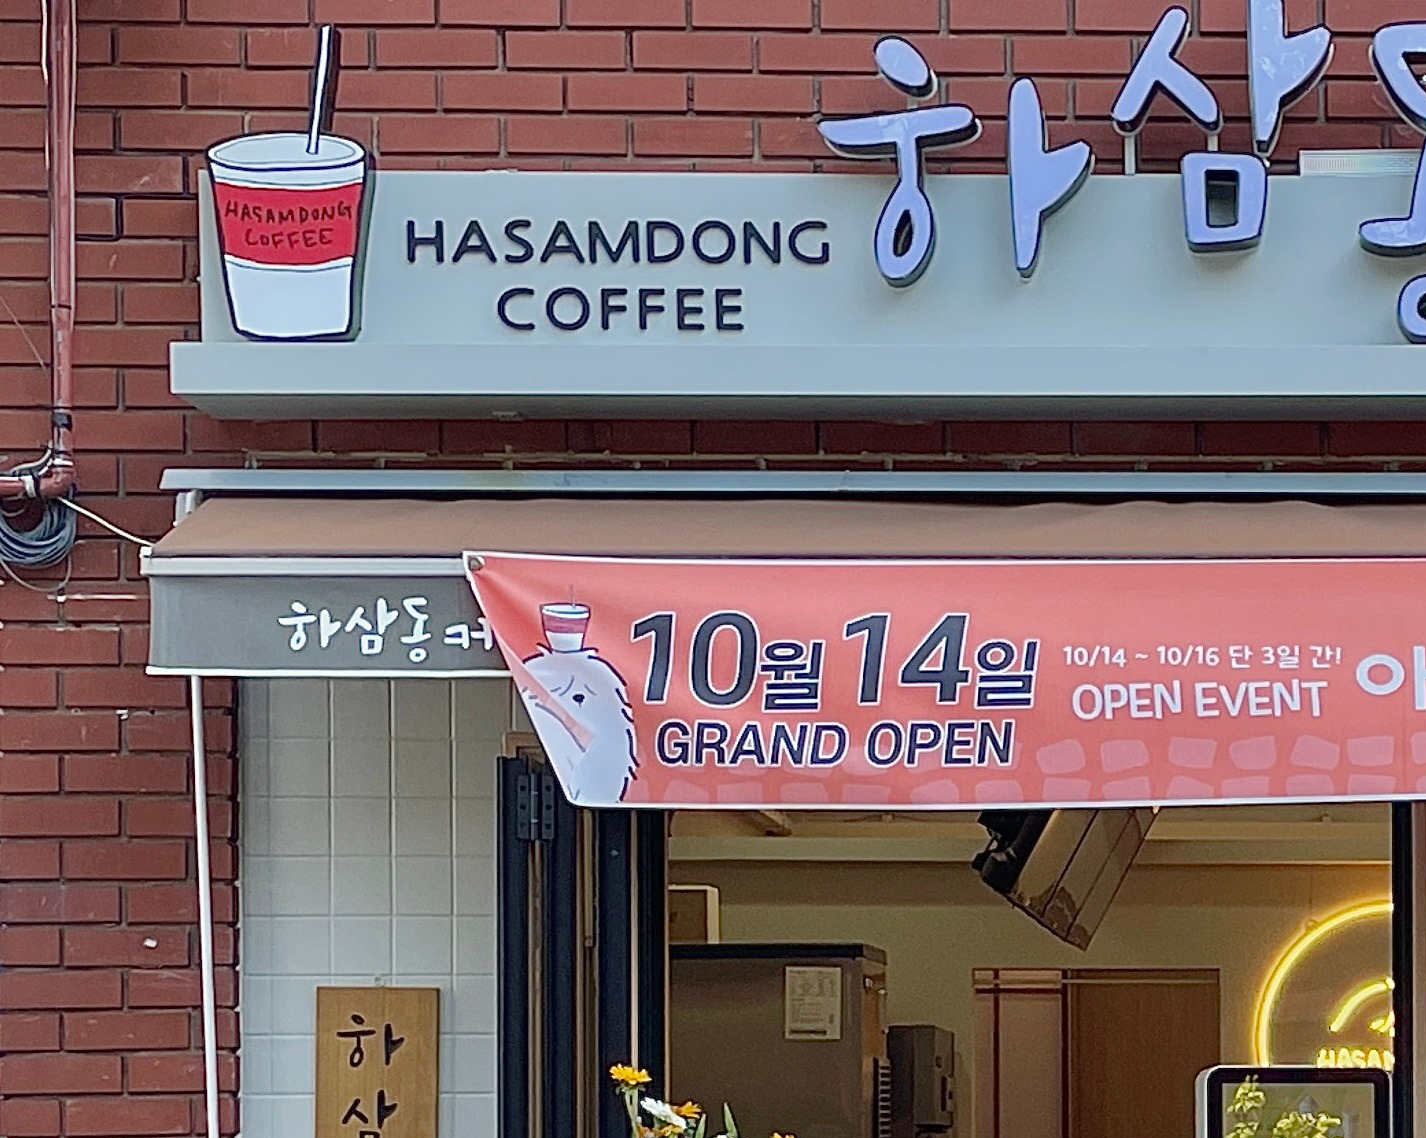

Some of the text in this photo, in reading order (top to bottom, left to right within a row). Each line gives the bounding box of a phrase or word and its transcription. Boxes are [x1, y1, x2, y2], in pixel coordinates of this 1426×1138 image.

[224, 200, 354, 225] HASAMDONG
[244, 226, 334, 248] COFFEE
[406, 219, 832, 266] HASAMDONG
[496, 286, 746, 332] COFFEE
[630, 611, 1041, 711] 10월 14일
[1062, 645, 1126, 668] 10/14
[1157, 644, 1220, 668] 10/16
[1229, 644, 1255, 669] 단
[1262, 644, 1301, 668] 3일
[1071, 678, 1329, 721] OPEN EVENT
[655, 719, 1016, 767] GRAND OPEN
